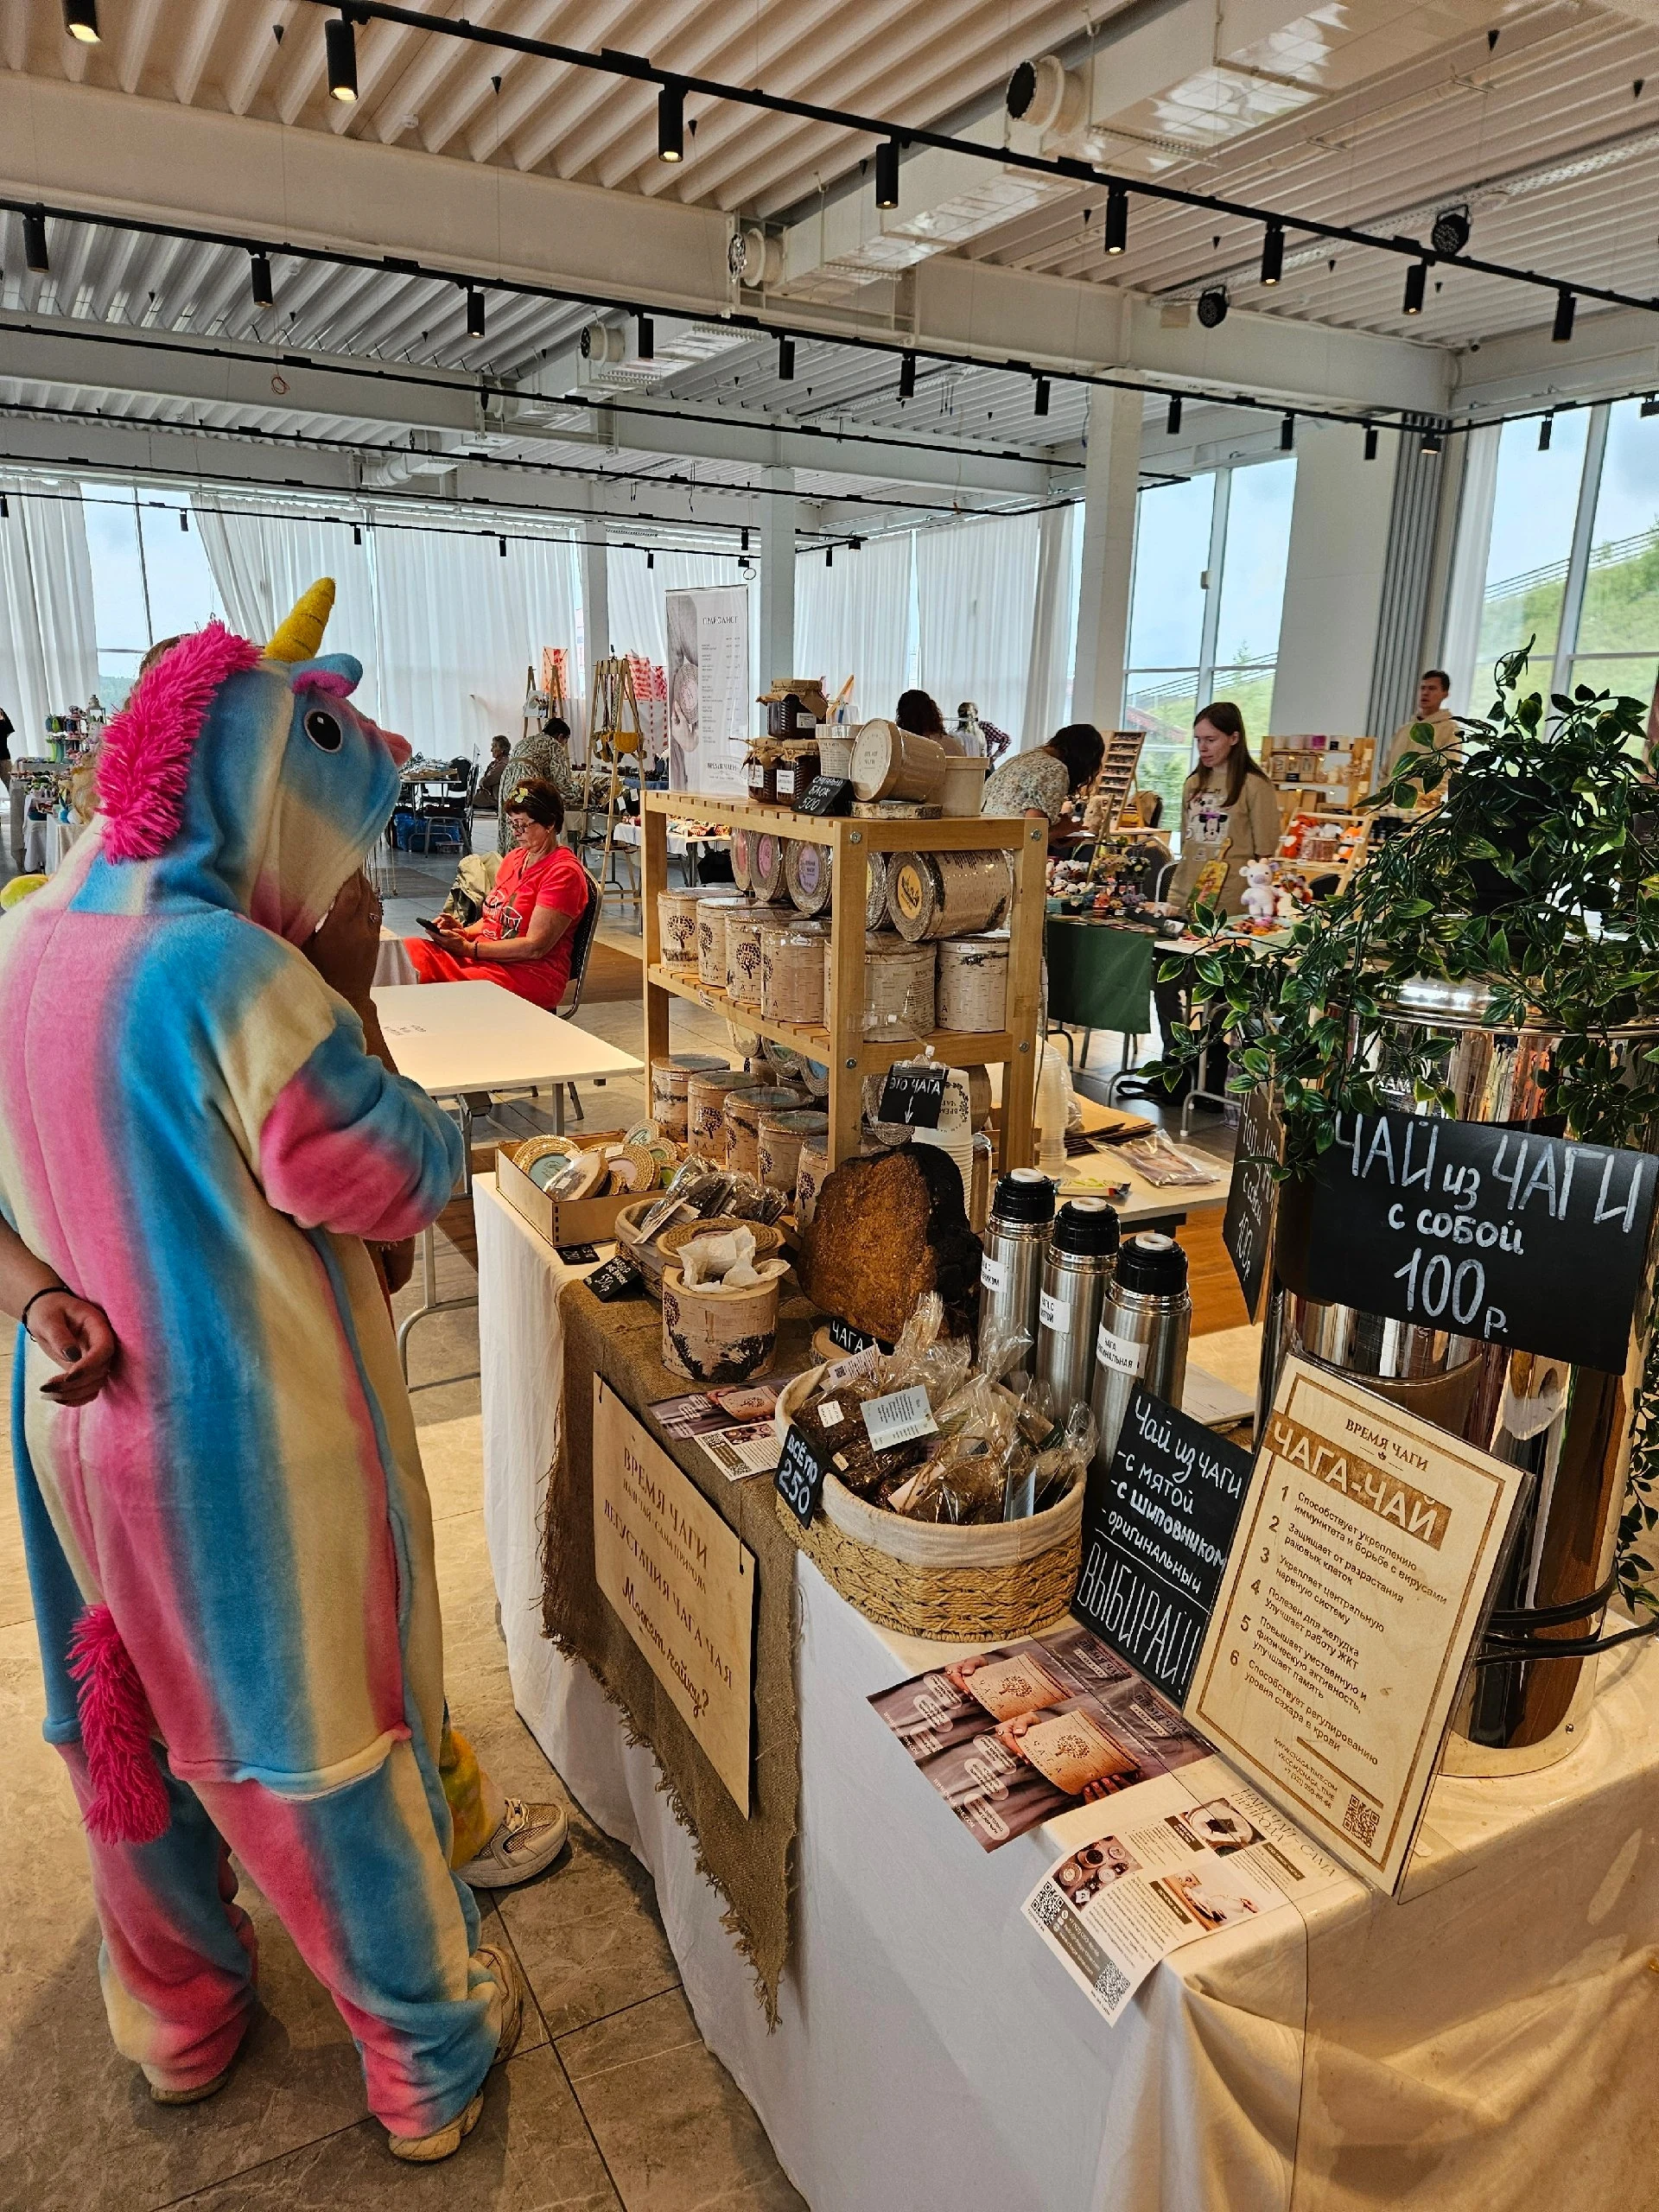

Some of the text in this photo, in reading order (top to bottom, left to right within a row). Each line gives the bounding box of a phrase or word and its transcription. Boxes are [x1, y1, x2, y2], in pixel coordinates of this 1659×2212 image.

[798, 797, 821, 810] 500
[911, 1077, 941, 1096] ЧАГА
[1335, 1109, 1440, 1192] ЧАЙ
[1491, 1135, 1643, 1234] ЧАГИ
[1394, 1248, 1485, 1325] 100
[832, 1320, 863, 1353] ЧАГА
[1274, 1421, 1438, 1541] ЧАГА-ЧАЙ
[1344, 1418, 1429, 1472] ВРЕМЯ ЧАГИ
[623, 1446, 708, 1570] ВРЕМЯ ЧАГИ
[779, 1459, 810, 1514] 250
[1268, 1516, 1404, 1604] 2 Защищает от разрастания
[1281, 1485, 1417, 1571] 1 Способствует укреплению
[1284, 1536, 1353, 1586] раковых клеток
[1294, 1504, 1344, 1541] иммунитета
[1347, 1537, 1353, 1546] и
[1355, 1541, 1389, 1568] борьбе
[1398, 1570, 1447, 1605] вирусами
[604, 1498, 733, 1690] ДЕГУСТАЦИЯ ЧАГА ЧАЯ
[622, 1576, 665, 1656] Может
[1250, 1580, 1360, 1657] 4 Полезен для желудка
[1260, 1547, 1384, 1632] 3 Укрепляет центральную
[1275, 1567, 1351, 1625] нервную систему
[1241, 1615, 1367, 1701] 5 Повышает умственную и
[1253, 1640, 1324, 1699] улучшает память
[1256, 1630, 1361, 1714] физическую активность,
[1265, 1598, 1359, 1670] Улучшает работу ЖКТ
[1230, 1650, 1378, 1765] 6 Способствует регулированию
[1244, 1672, 1274, 1699] уровня
[1275, 1695, 1304, 1723] сахара
[1313, 1728, 1341, 1752] крови
[1230, 1791, 1287, 1843] ПРИРОДА
[1240, 1788, 1269, 1820] НАШ
[1272, 1813, 1297, 1838] ЧАЙ
